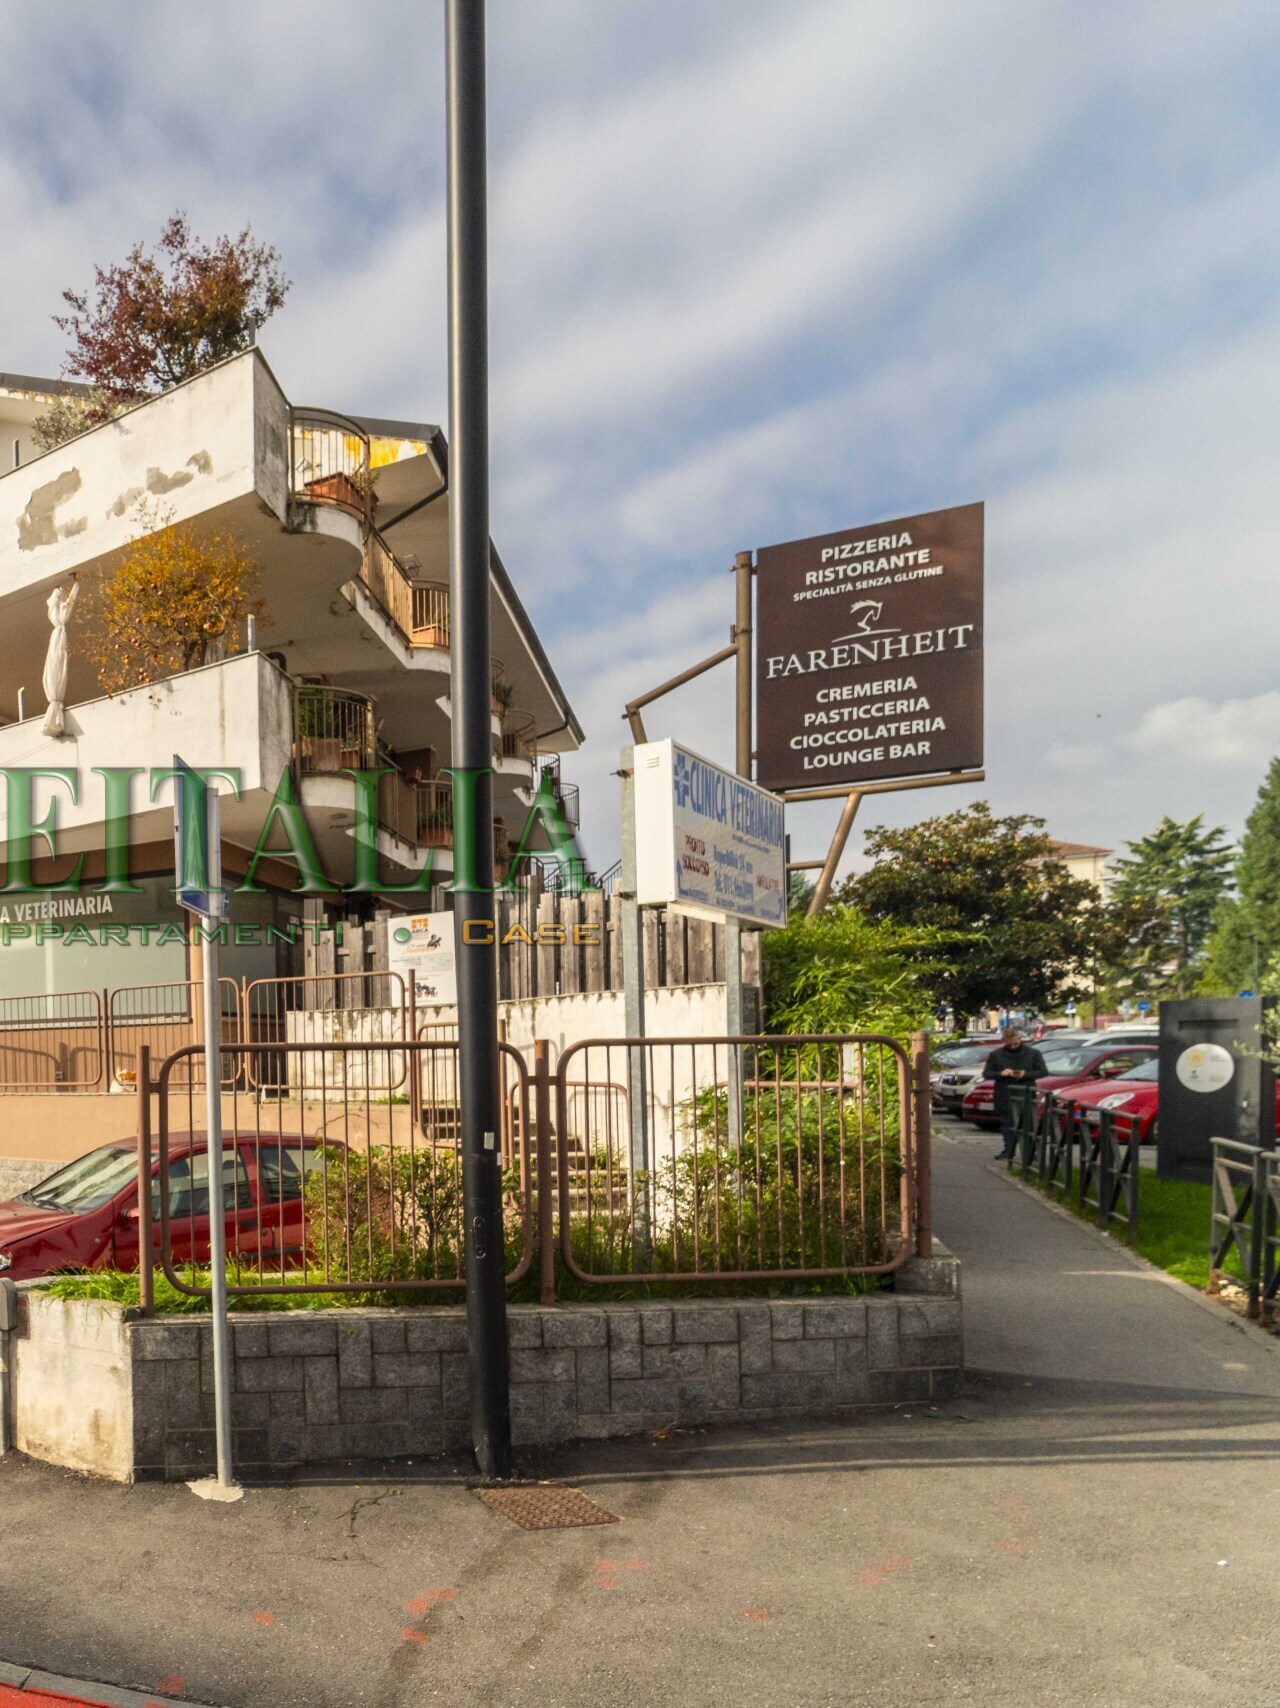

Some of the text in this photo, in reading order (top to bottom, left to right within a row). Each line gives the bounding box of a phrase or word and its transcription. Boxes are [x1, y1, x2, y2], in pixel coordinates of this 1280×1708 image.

[821, 532, 913, 563] PIZZERIA
[793, 565, 944, 602] SPECIALITÀ SENZA GLUTINE
[805, 549, 930, 586] RISTORANTE
[766, 624, 974, 679] FARENHEIT
[816, 676, 917, 703] CREMERIA
[804, 696, 930, 727] PASTICCERIA
[790, 717, 946, 750] CIOCCOLATERIA
[804, 741, 931, 770] LOUNGE BAR
[689, 760, 783, 849] CLINICA VETERINARIA
[14, 895, 113, 921] VETERINARIA
